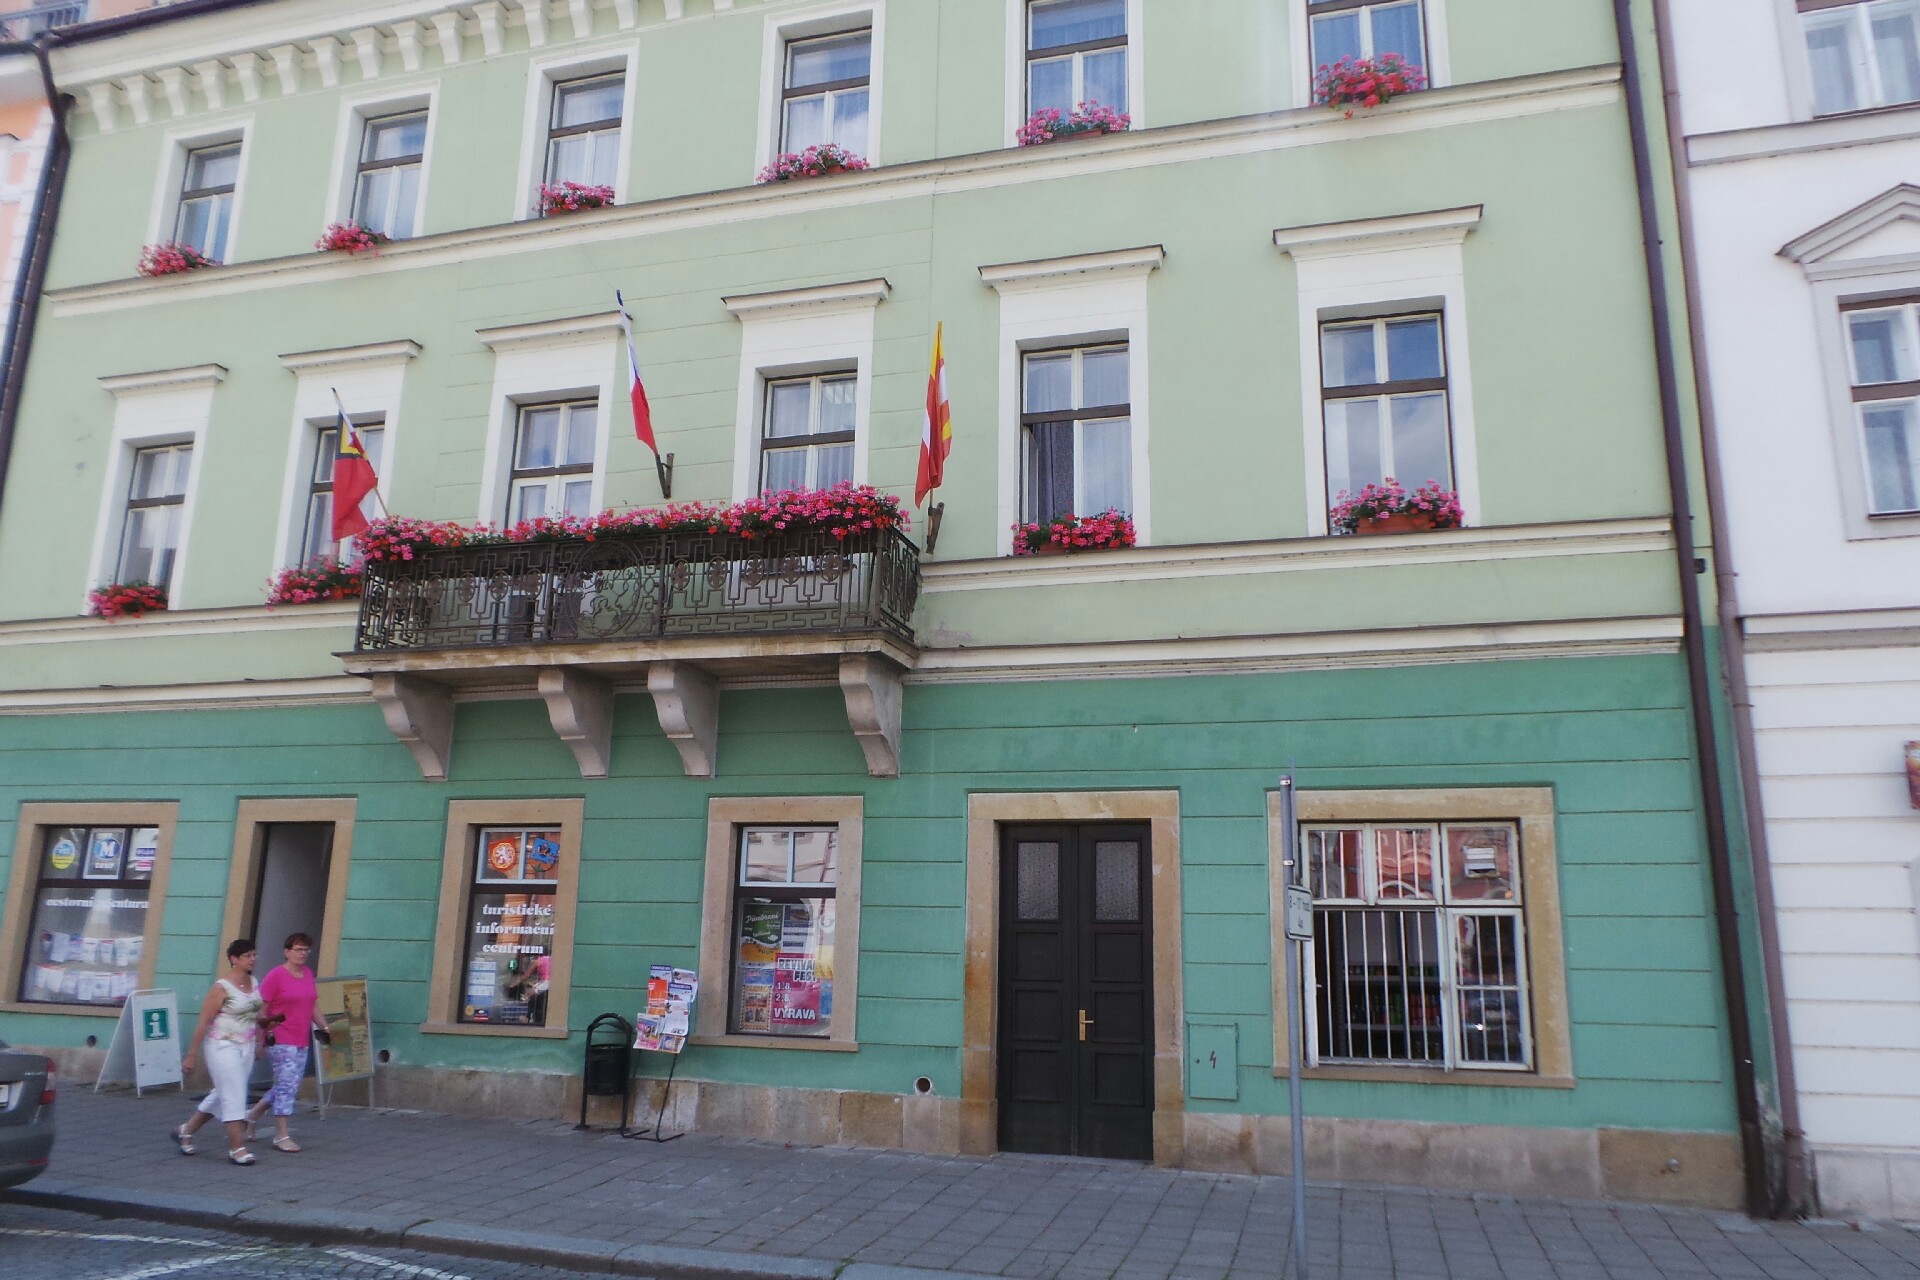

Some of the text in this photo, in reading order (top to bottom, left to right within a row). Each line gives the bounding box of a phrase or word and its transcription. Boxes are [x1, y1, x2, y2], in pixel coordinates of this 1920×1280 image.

[100, 840, 116, 857] M
[482, 903, 552, 916] turistické
[475, 921, 554, 935] informační
[482, 943, 544, 954] centrum
[774, 1005, 816, 1020] VÝRAVA
